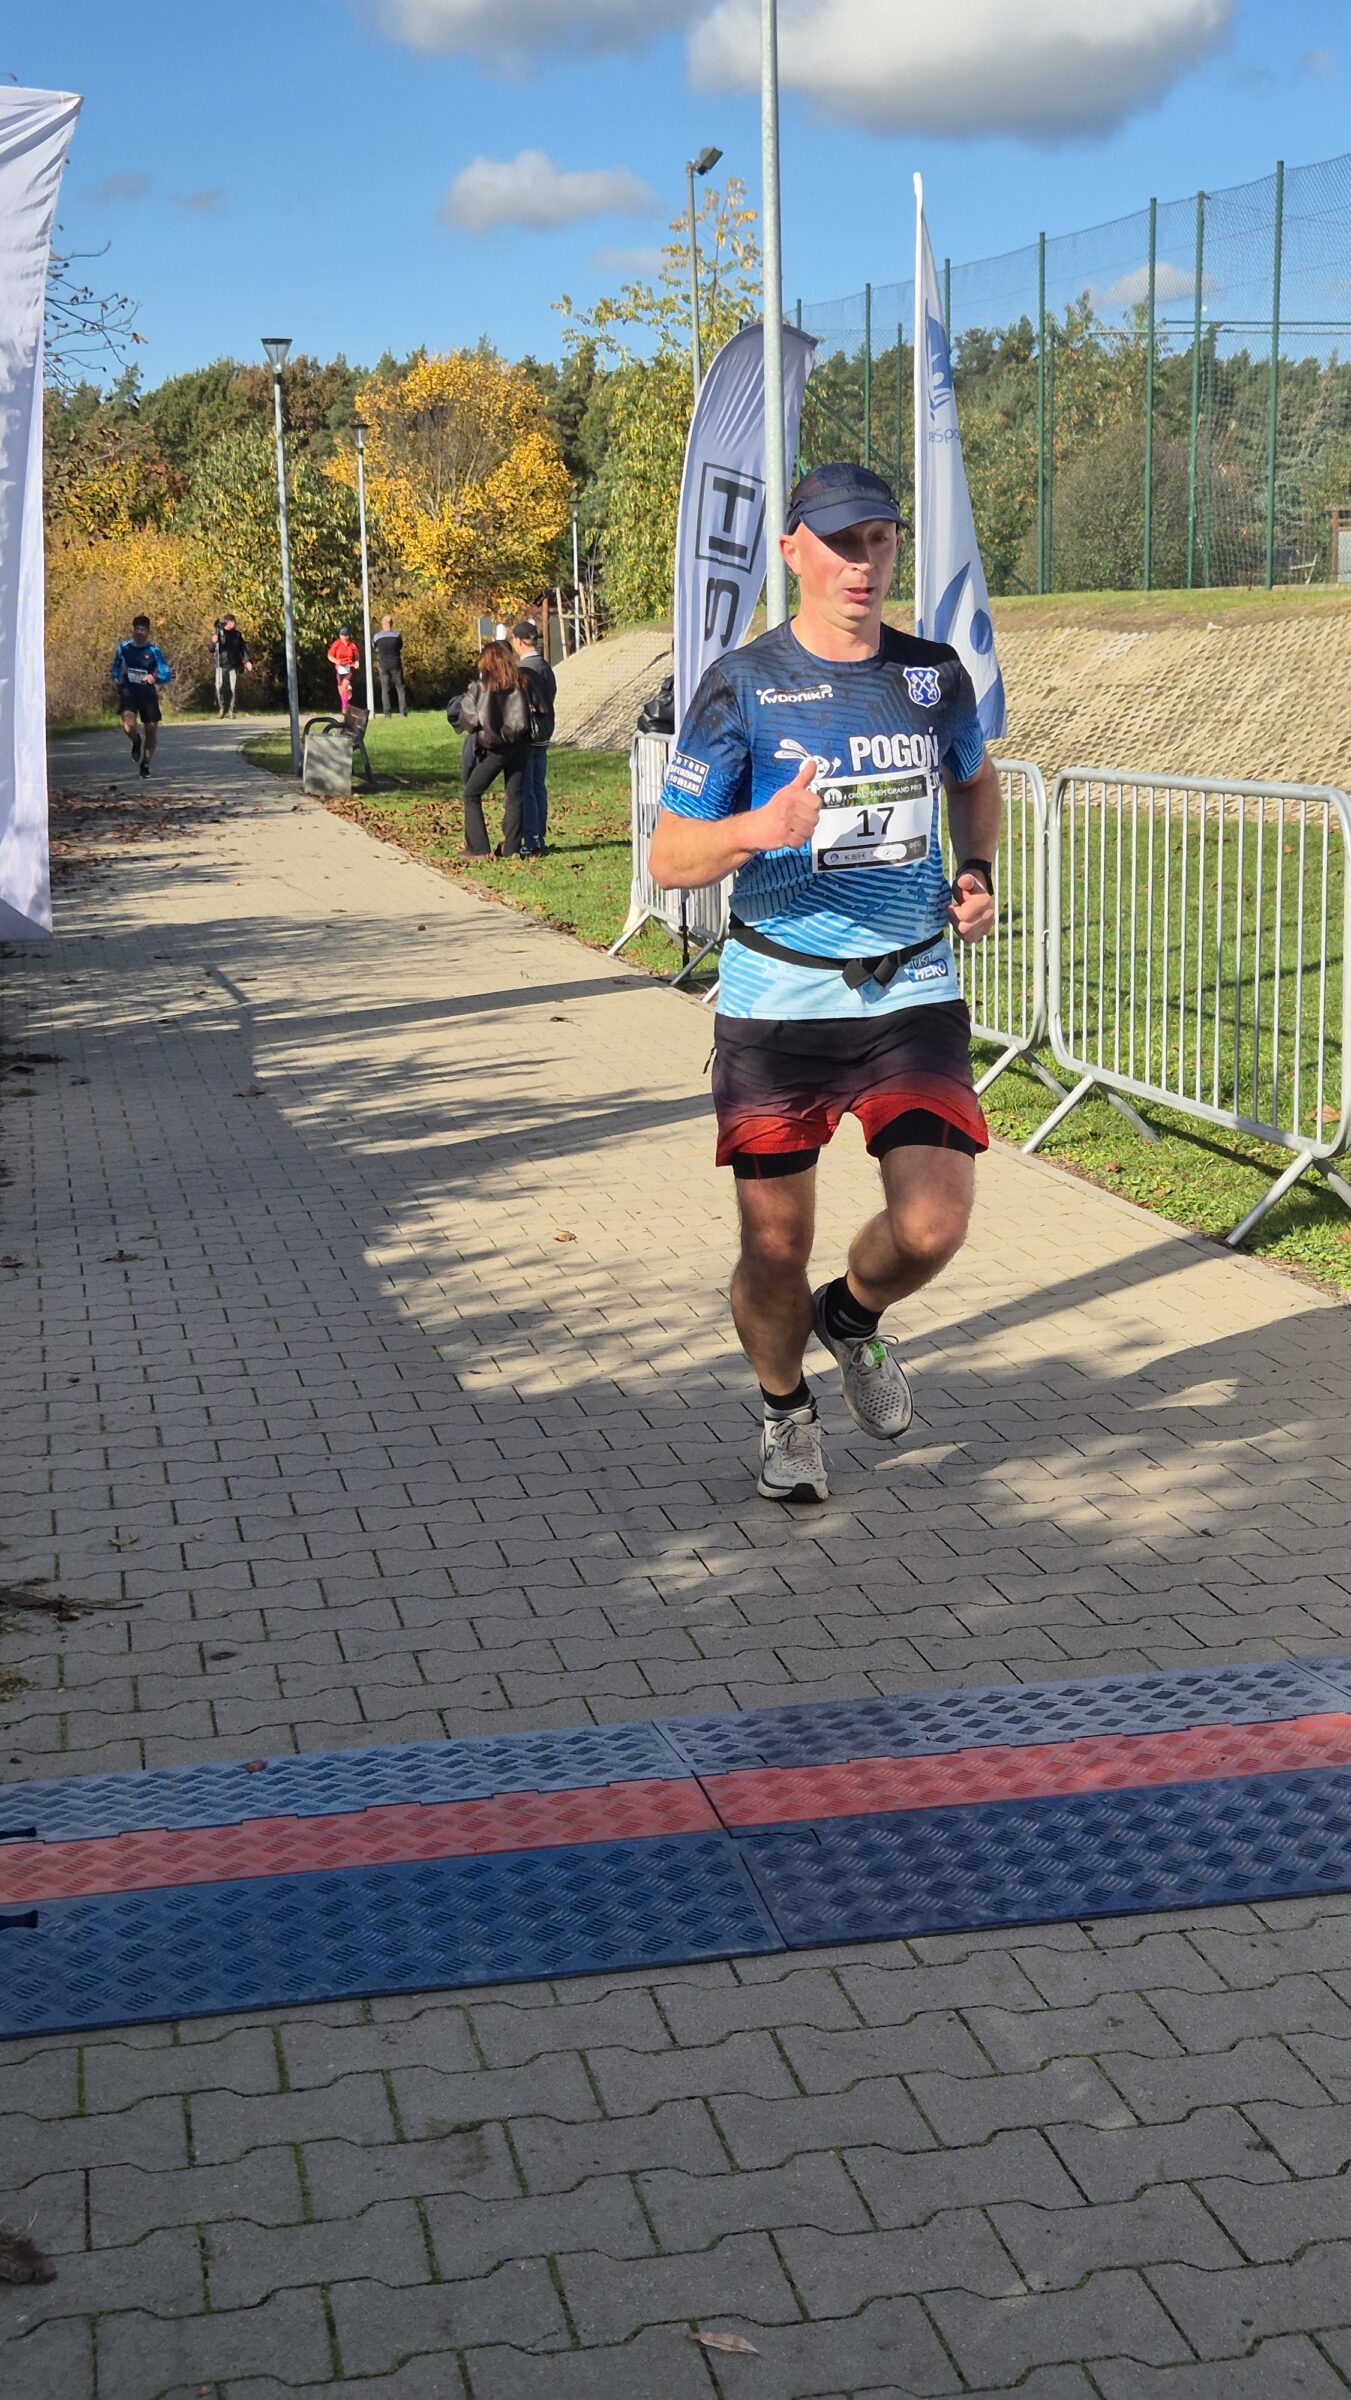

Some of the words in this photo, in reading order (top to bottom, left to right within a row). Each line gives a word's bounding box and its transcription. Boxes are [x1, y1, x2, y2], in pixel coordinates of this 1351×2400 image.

[849, 726, 939, 772] POGOŃ
[848, 790, 868, 800] CROSS
[887, 785, 910, 796] GRAND
[910, 783, 922, 792] PRIX
[856, 806, 895, 838] 17
[844, 852, 865, 860] KSH
[913, 960, 947, 980] HERO
